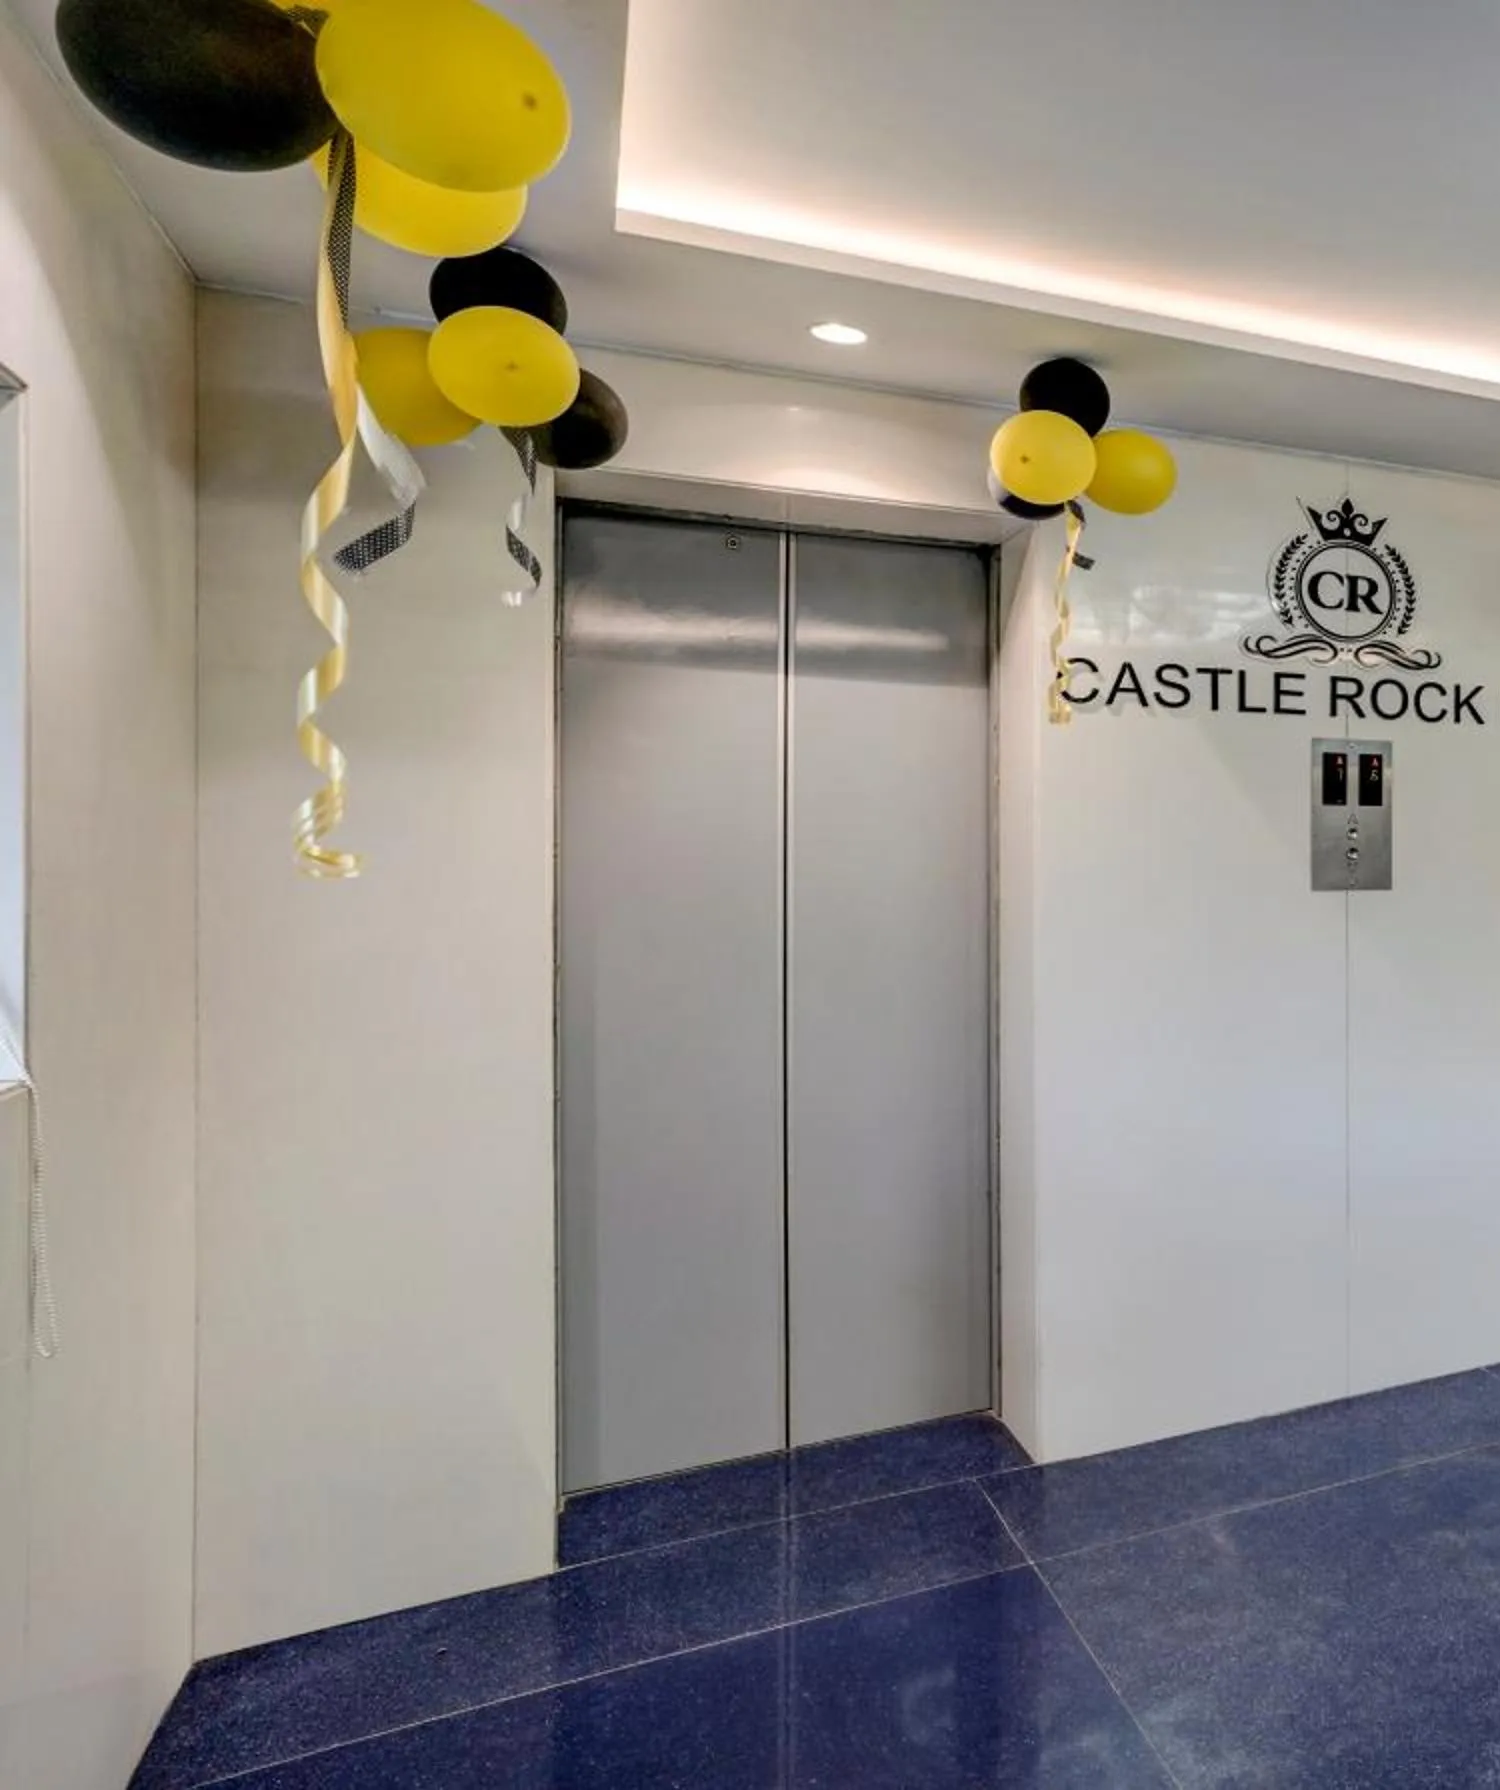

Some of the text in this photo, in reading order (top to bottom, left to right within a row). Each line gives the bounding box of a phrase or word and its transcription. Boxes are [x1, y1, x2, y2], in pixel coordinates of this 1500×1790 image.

[1307, 571, 1383, 615] CR
[1057, 657, 1306, 714] CASTLE
[1328, 676, 1485, 724] ROCK
